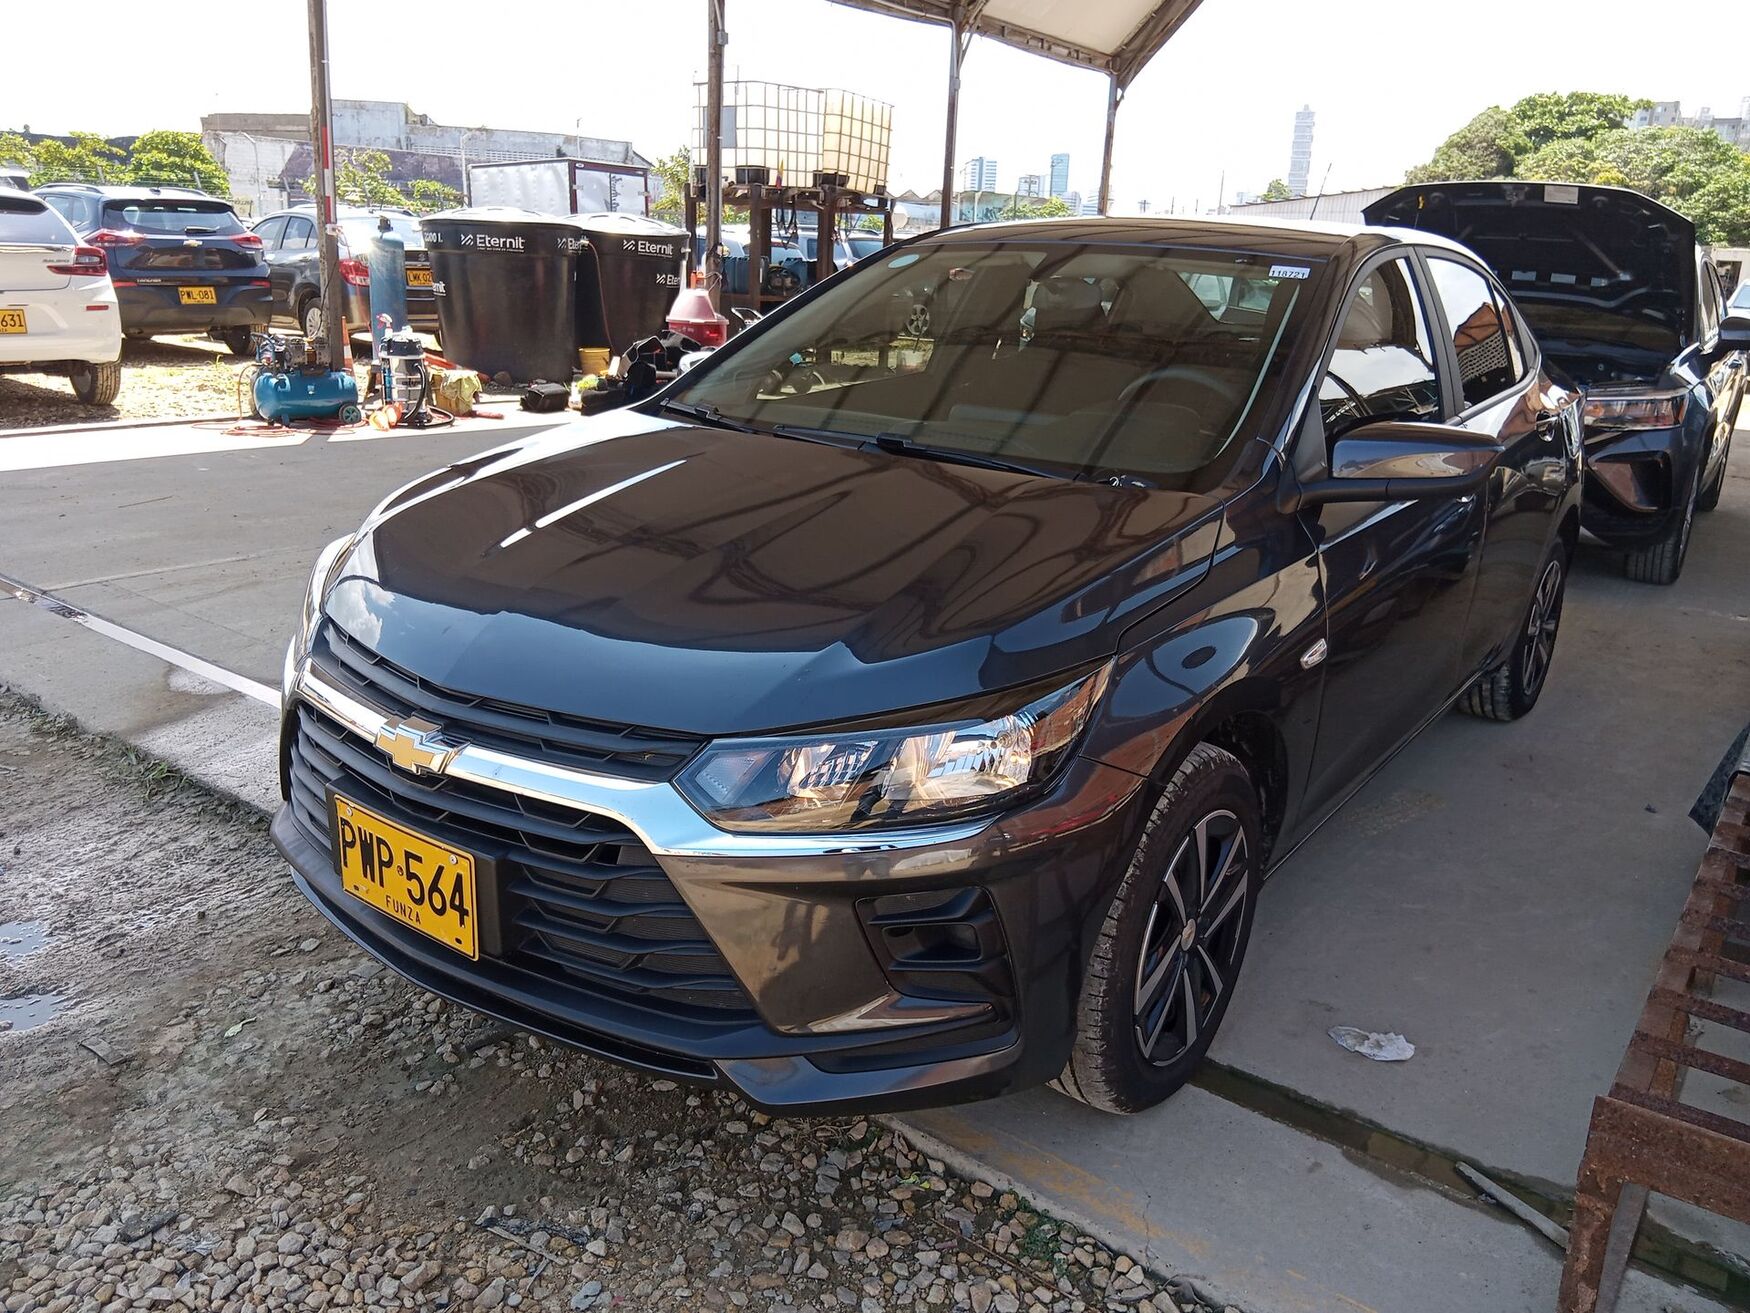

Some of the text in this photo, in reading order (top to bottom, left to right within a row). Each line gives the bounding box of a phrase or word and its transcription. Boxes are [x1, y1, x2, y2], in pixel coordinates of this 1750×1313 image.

[476, 234, 525, 249] Eternit
[638, 241, 674, 255] Eternit
[667, 274, 681, 285] Eter
[0, 314, 24, 327] 631
[340, 817, 469, 928] PWP 564
[386, 894, 422, 925] FUNZA
